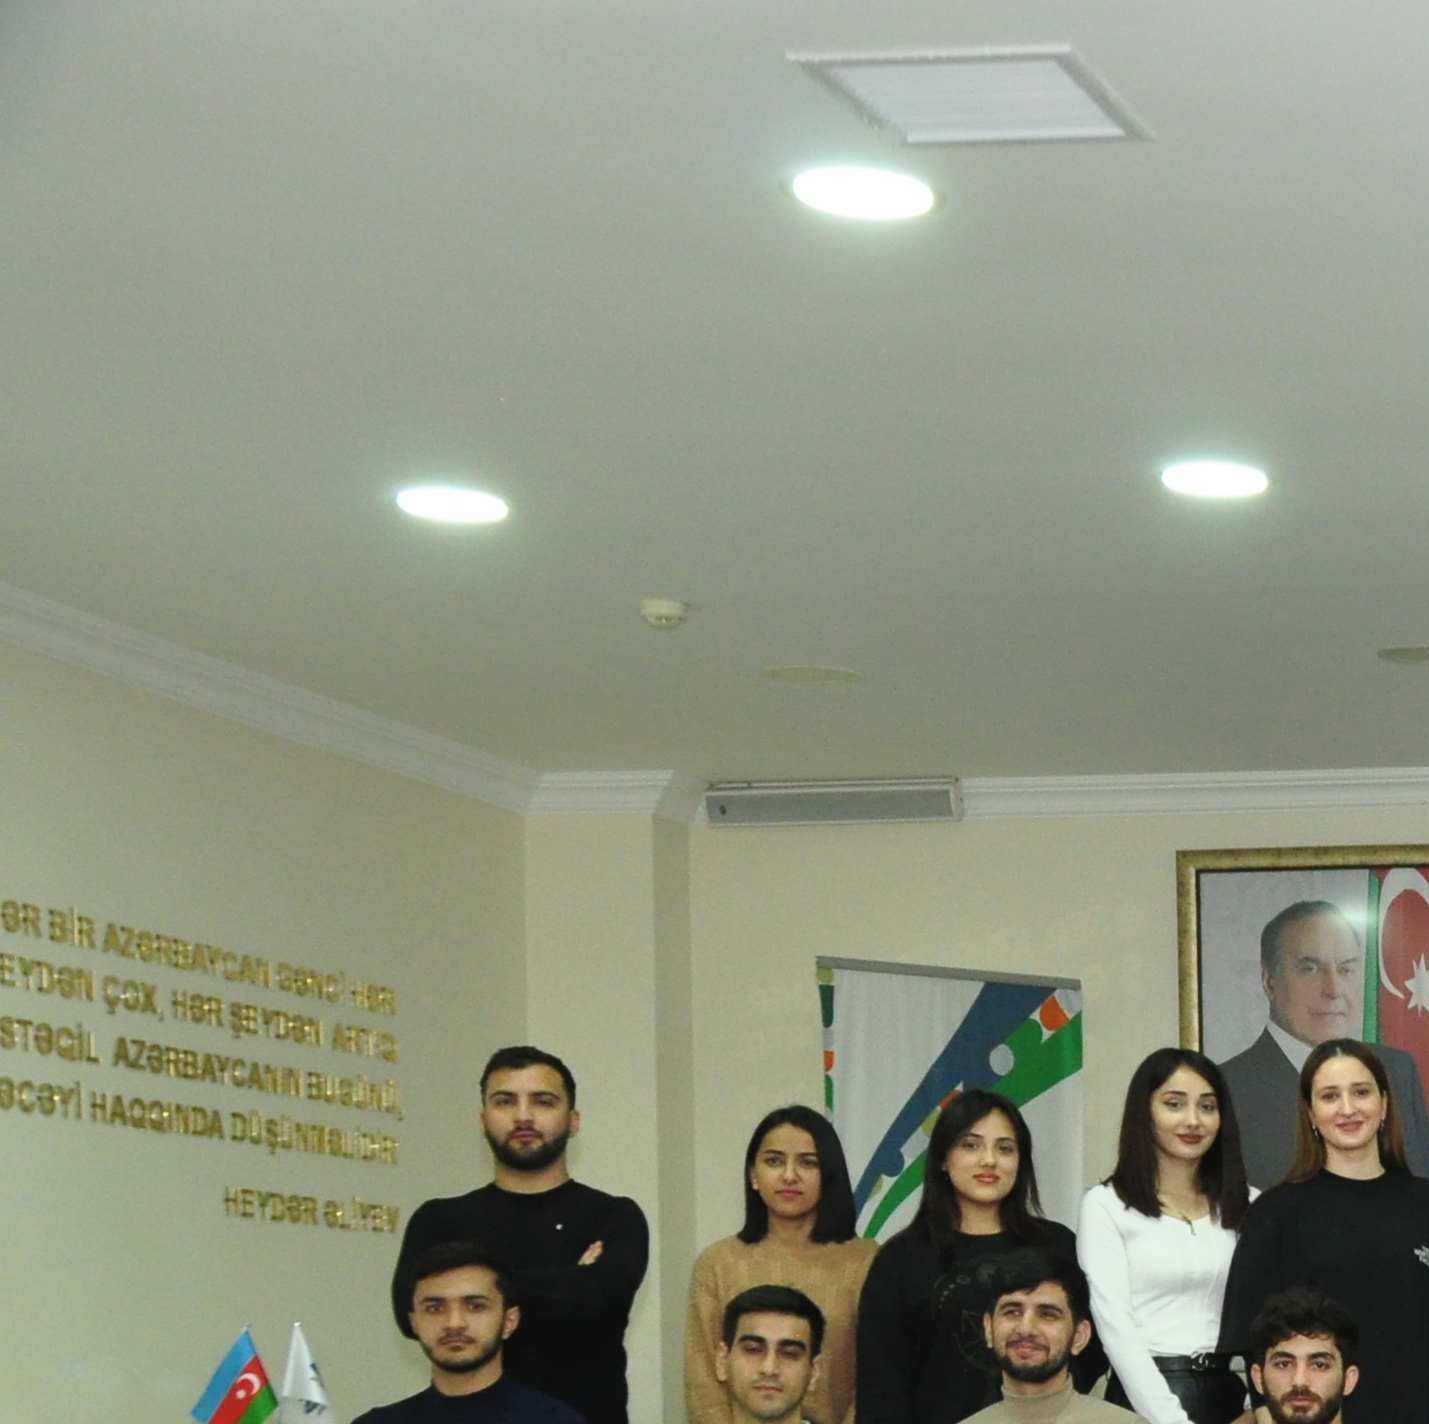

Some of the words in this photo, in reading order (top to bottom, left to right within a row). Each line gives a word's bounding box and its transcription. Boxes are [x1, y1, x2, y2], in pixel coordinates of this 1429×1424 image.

[0, 899, 42, 938] ƏR
[48, 907, 96, 949] BİR
[103, 923, 273, 989] AZƏRBAYCAN
[0, 952, 96, 1001] EYDƏN
[171, 989, 225, 1028] HƏR
[229, 1002, 325, 1047] ŞEYDƏN
[0, 1015, 101, 1063] STƏQİL
[0, 1076, 85, 1121] ƏCƏYİ
[90, 1090, 226, 1141] HAQQINDA
[224, 1186, 318, 1226] HEYDƏR
[323, 1195, 401, 1234] ƏLİYEV
